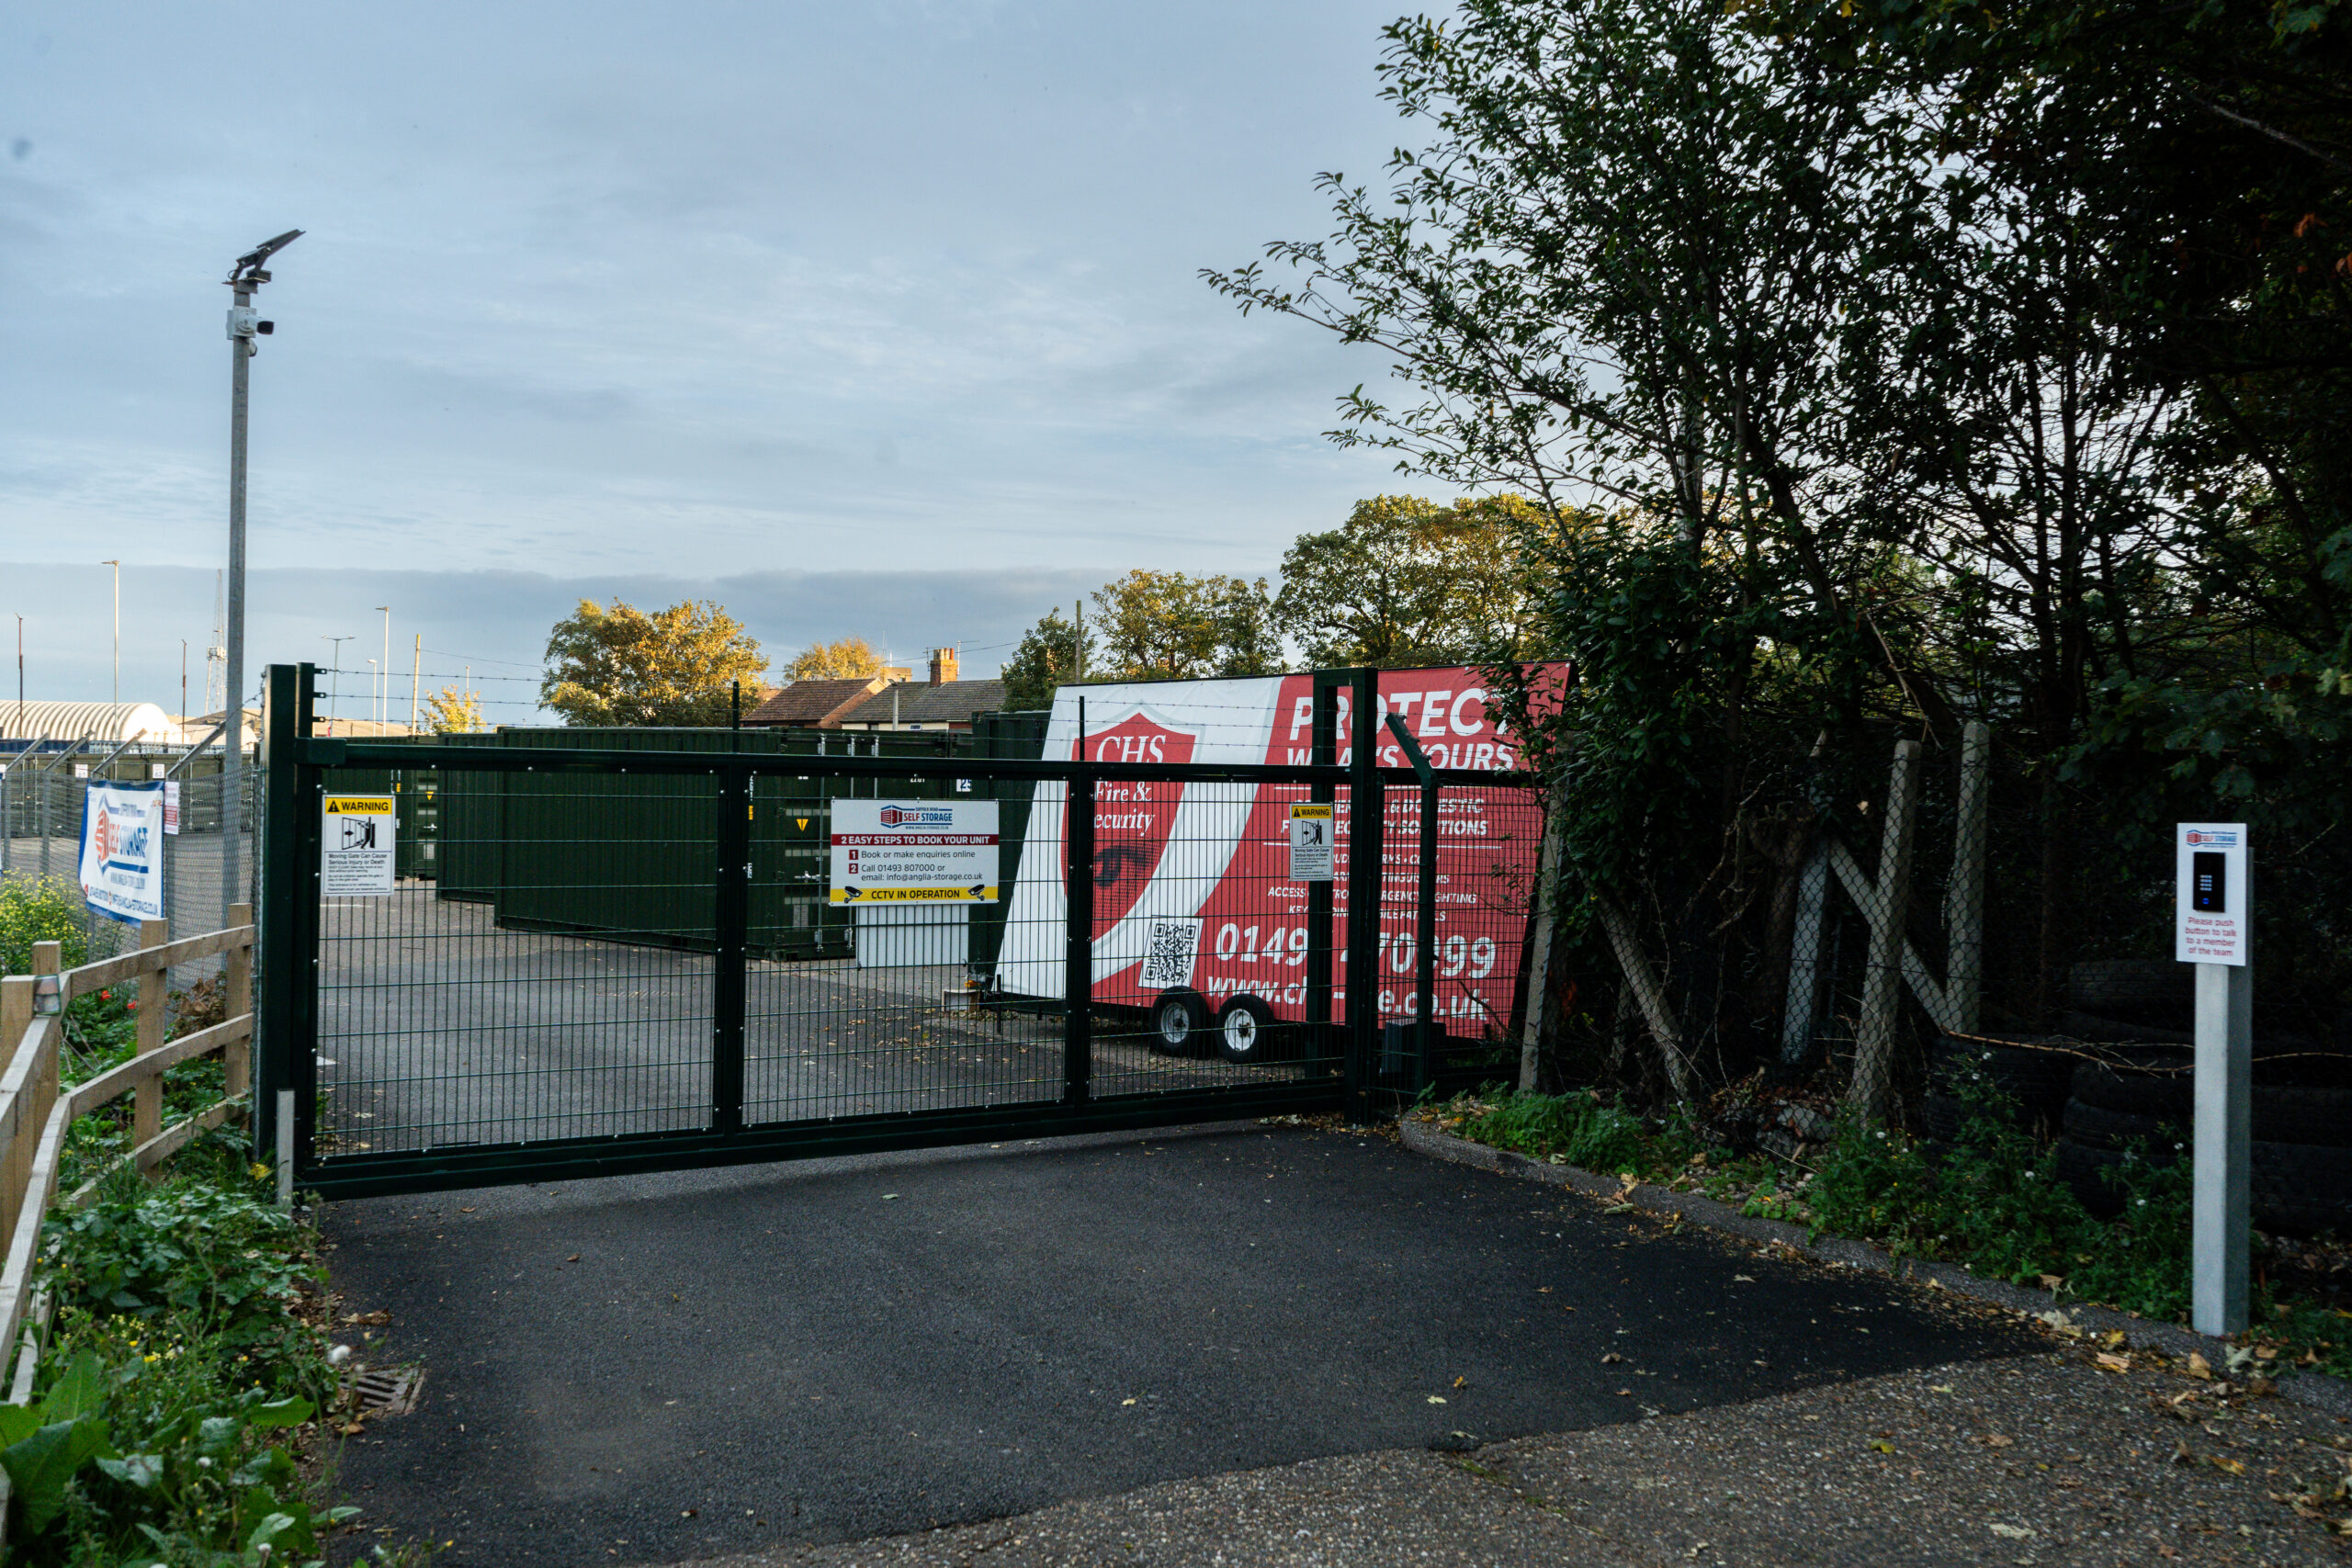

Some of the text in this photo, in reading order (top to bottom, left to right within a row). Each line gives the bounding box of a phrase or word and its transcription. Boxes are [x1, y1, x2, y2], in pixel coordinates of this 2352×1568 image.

[1097, 735, 1166, 763] CHS
[1133, 781, 1152, 802] &
[341, 802, 389, 811] WARNING
[903, 813, 953, 821] SELF STORAGE
[1094, 808, 1155, 837] ecurity
[874, 836, 902, 844] STEPS
[903, 836, 916, 844] TO
[917, 836, 944, 844] BOOK
[944, 836, 968, 844] YOUR
[969, 836, 990, 844] UNIT
[852, 851, 856, 859] 1
[916, 851, 950, 859] enquiries
[851, 864, 856, 873] 2
[904, 863, 935, 872] 807000
[887, 873, 983, 882] info@anglia-storage.co.uk
[871, 889, 960, 899] CCTV IN OPERATION
[1268, 886, 1306, 898] ACCESS
[1288, 905, 1309, 915] KEY
[2188, 916, 2212, 925] Please
[2213, 948, 2233, 956] team
